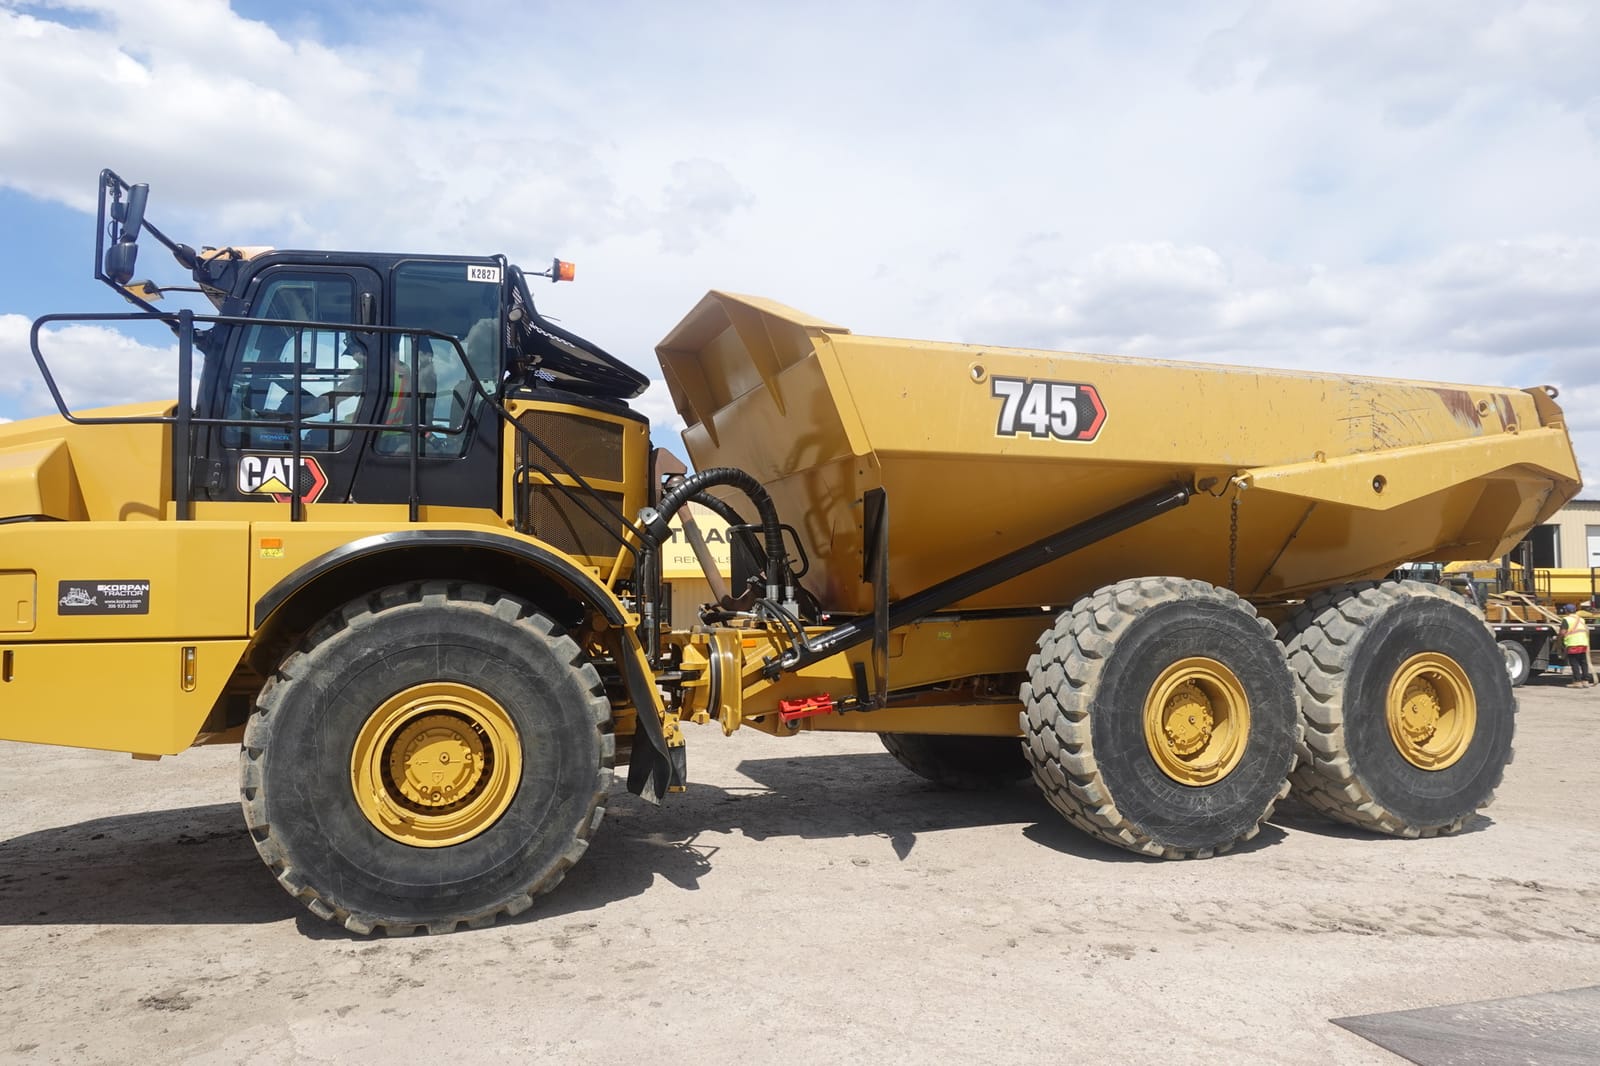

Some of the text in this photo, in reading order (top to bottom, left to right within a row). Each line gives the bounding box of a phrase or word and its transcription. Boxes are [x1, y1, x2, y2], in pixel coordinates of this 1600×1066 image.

[471, 268, 496, 280] K2827
[994, 380, 1078, 436] 745
[240, 456, 305, 493] CAT
